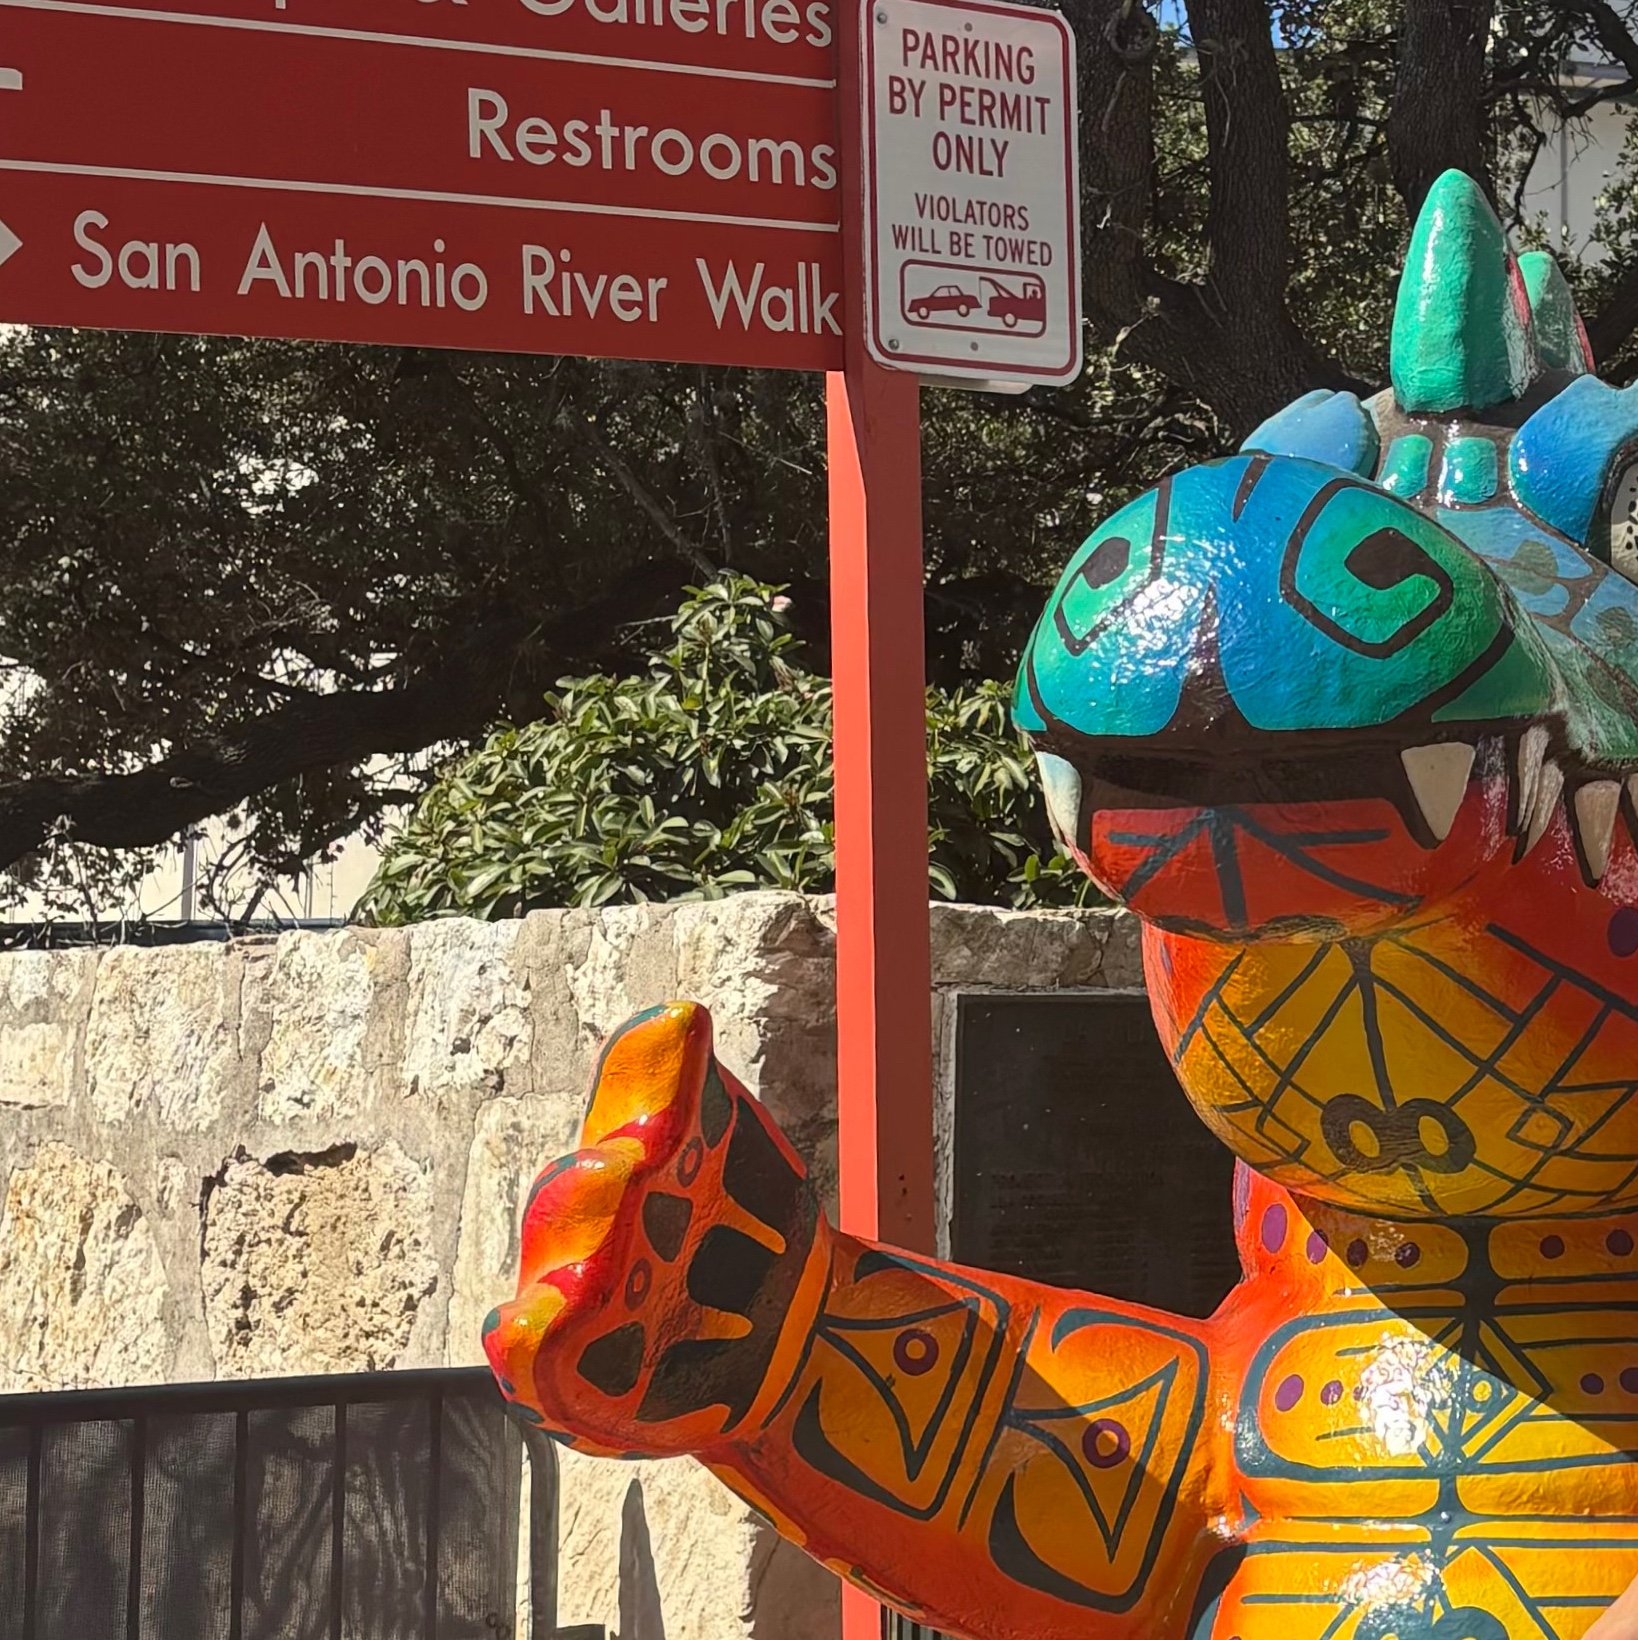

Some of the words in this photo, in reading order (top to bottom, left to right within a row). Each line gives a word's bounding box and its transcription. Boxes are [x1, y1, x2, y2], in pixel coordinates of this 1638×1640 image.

[902, 28, 1036, 85] PARKING
[888, 75, 926, 118] BY
[938, 82, 1051, 136] PERMIT
[468, 88, 838, 191] Restrooms
[932, 131, 1009, 178] ONLY
[914, 192, 1029, 232] VIOLATORS
[72, 210, 202, 293] San
[237, 222, 489, 313] Antonio
[522, 244, 668, 323] River
[696, 257, 843, 338] Walk
[892, 224, 942, 254] WILL
[949, 231, 976, 259] BE
[982, 235, 1052, 267] TOWED
